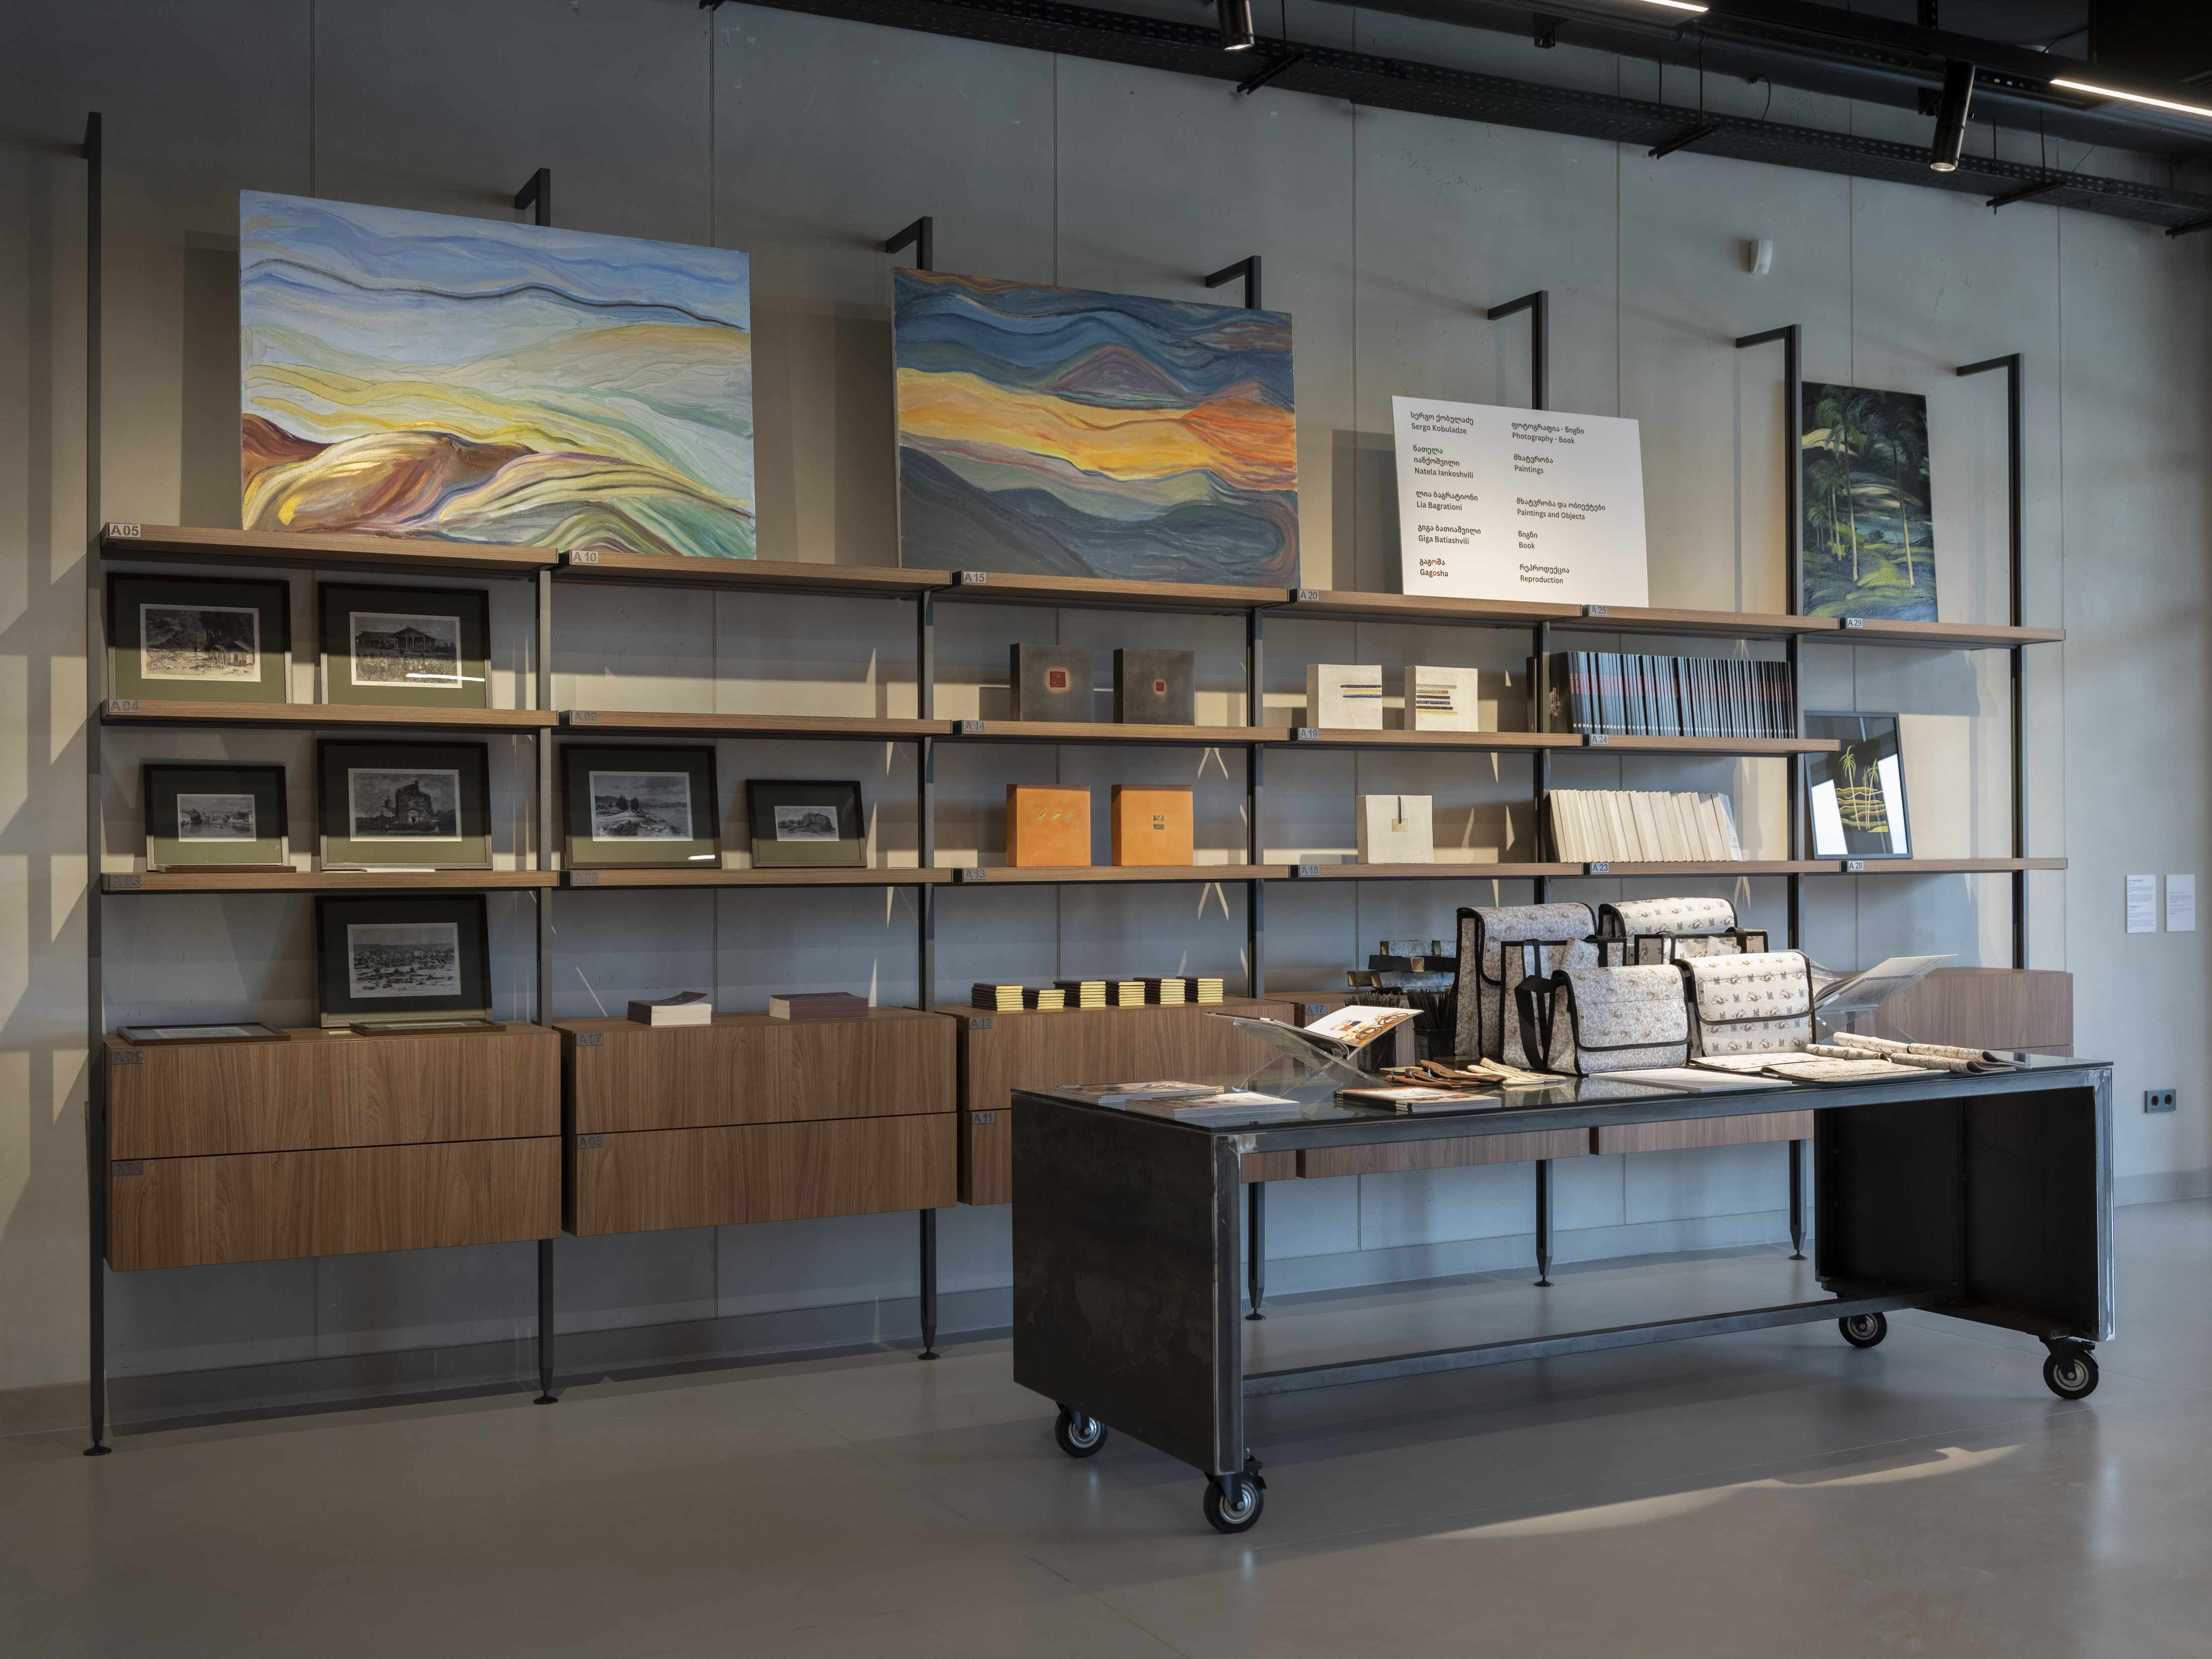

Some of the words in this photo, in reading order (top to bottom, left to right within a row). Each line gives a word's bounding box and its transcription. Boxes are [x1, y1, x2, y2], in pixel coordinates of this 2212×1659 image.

[1410, 411, 1435, 422] სერგო
[1436, 414, 1474, 426] ქობულაძე
[1411, 422, 1431, 432] Sergo
[1432, 424, 1467, 434] Kobuladze
[1511, 422, 1560, 433] ფოტოგრაფია
[1564, 426, 1584, 435] წიგნი
[1512, 432, 1553, 444] Photography
[1413, 444, 1443, 455] ნათელა
[1414, 456, 1460, 468] იანქოშვილი
[1513, 453, 1553, 464] მხატვრობა
[1414, 467, 1437, 476] Natela
[1438, 469, 1473, 479] Iankoshvili
[1514, 465, 1544, 475] Paintings
[1416, 491, 1432, 499] ლია
[1433, 491, 1478, 502] ბაგრატიონი
[1428, 502, 1462, 511] Bagrationi
[1516, 497, 1556, 508] მხატვრობა
[1568, 502, 1606, 512] ობიექტები
[1517, 508, 1546, 519] Paintings
[1561, 512, 1586, 521] Objects
[1418, 524, 1434, 533] გიგა
[1435, 524, 1481, 536] ბათიაშვილი
[1518, 530, 1538, 540] წიგნი
[1418, 534, 1434, 544] Giga
[1434, 535, 1469, 545] Batiashvili
[1519, 541, 1535, 549] Book
[1419, 558, 1445, 567] გაგოშა
[1420, 569, 1449, 578] Gagosha
[1519, 564, 1570, 575] რეპროდუქცია
[1520, 575, 1563, 584] Reproduction
